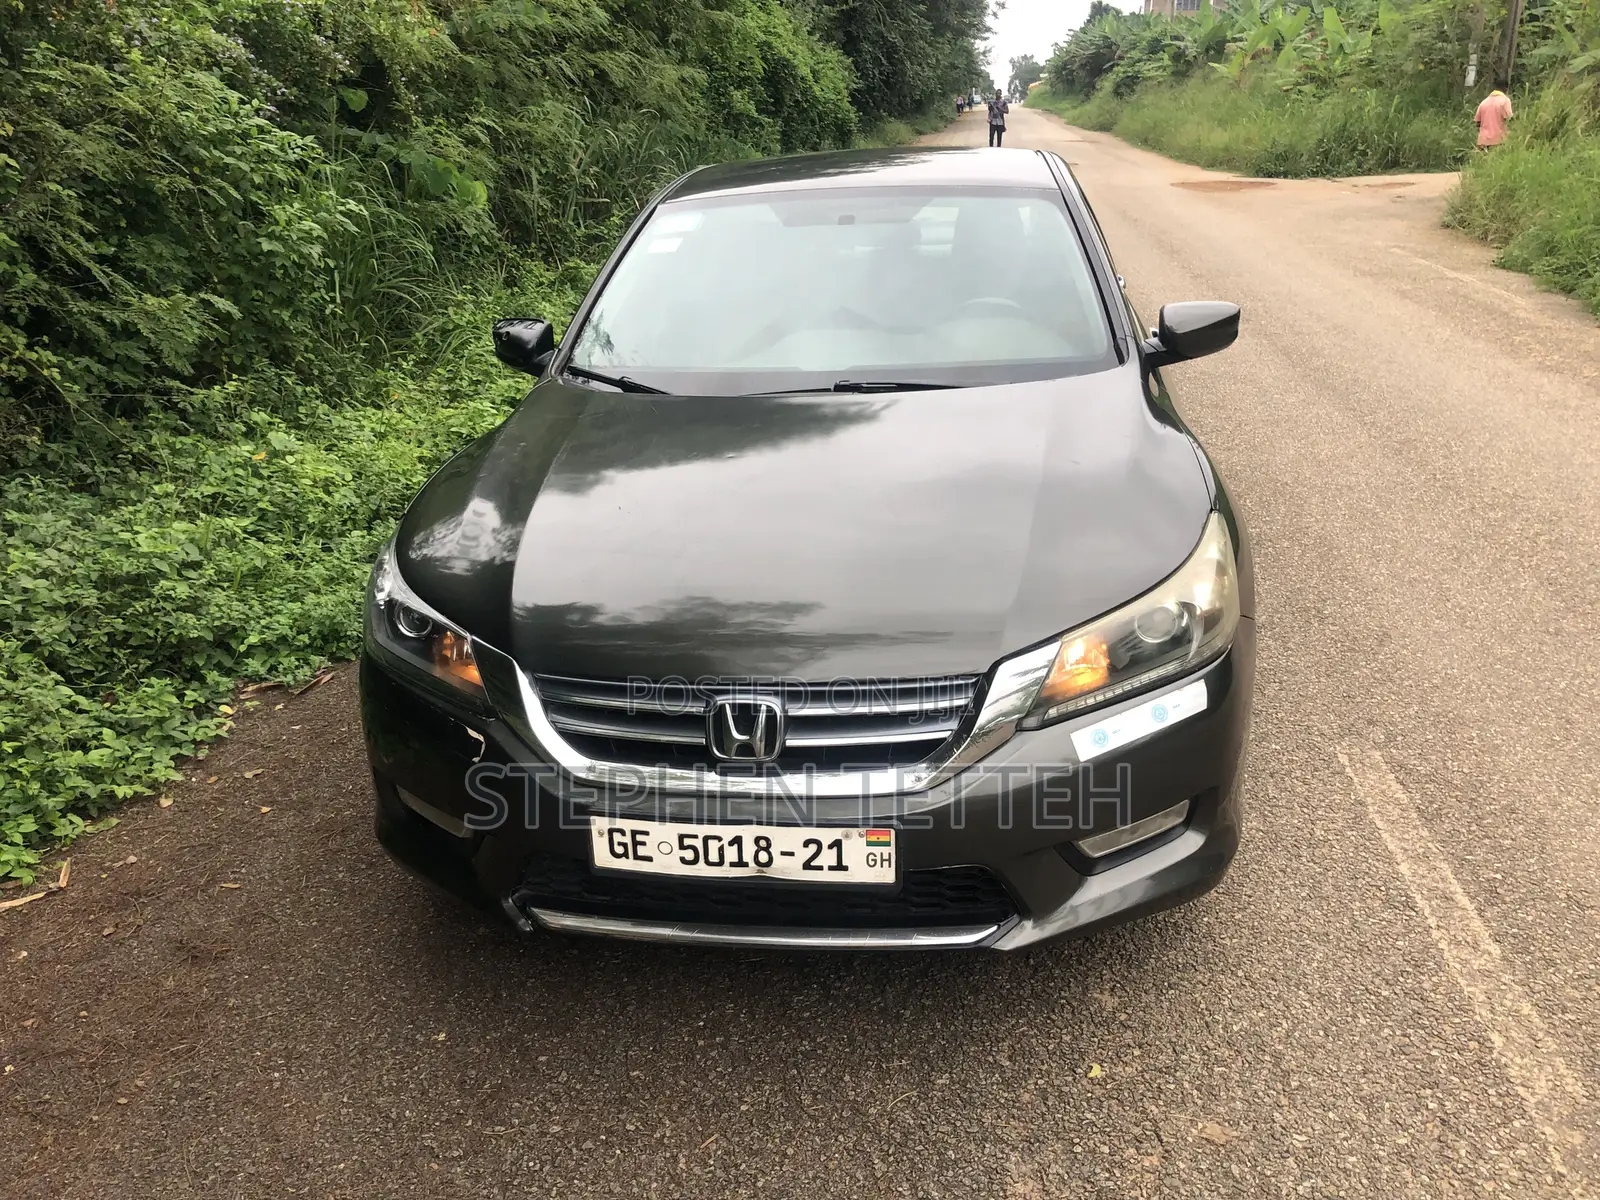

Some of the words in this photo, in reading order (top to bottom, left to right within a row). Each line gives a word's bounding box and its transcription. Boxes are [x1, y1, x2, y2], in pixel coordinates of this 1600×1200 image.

[607, 827, 654, 862] GE
[677, 833, 849, 871] 5018-21
[866, 851, 892, 868] GH
